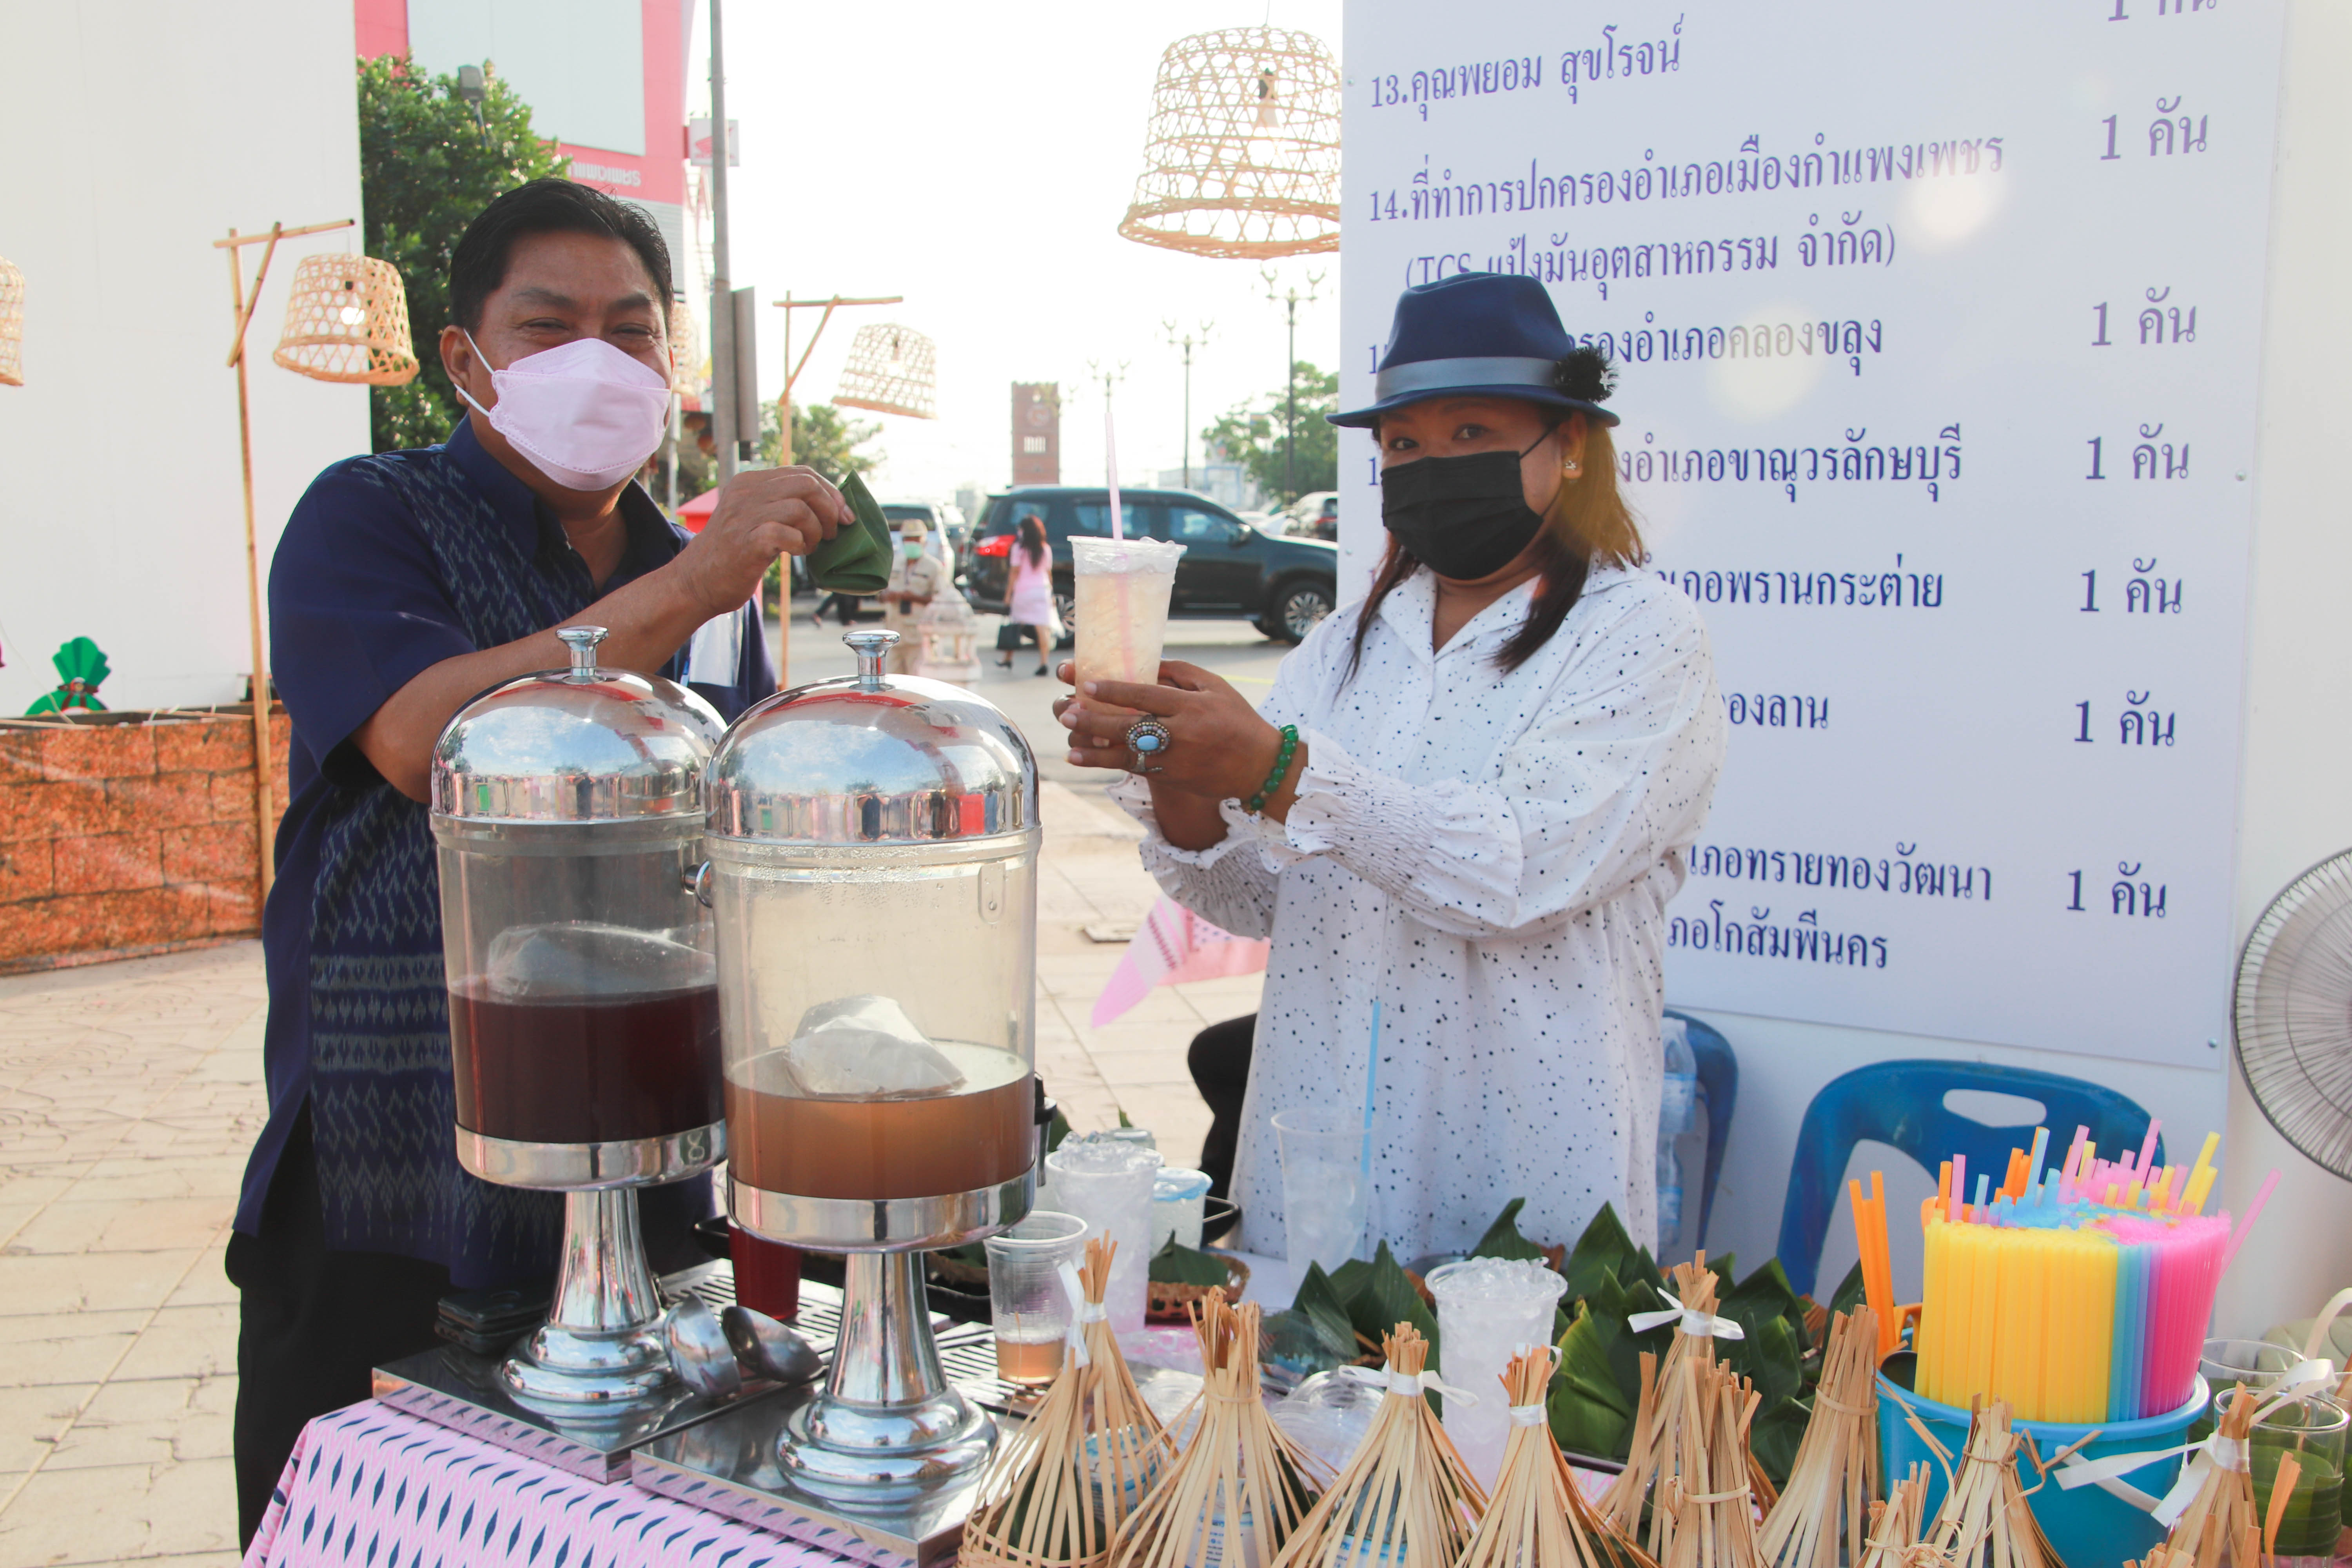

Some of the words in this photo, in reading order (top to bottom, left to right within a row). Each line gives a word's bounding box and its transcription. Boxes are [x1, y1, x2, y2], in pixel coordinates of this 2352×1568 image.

[1371, 56, 1542, 122] 13.คุณพยอม
[1561, 13, 1684, 105] สุขโรจน์
[2100, 115, 2121, 160] 1
[2149, 96, 2207, 156] คัน
[1370, 132, 2003, 221] 14.ที่ทำการปกครองอำเภอเมืองกำแพงเพชร
[1798, 211, 1895, 268] จำกัด)
[2091, 302, 2111, 346] 1
[2139, 287, 2196, 345] คัน
[2085, 437, 2105, 480] 1
[2132, 423, 2189, 480] คัน
[2080, 569, 2100, 612] 1
[2126, 558, 2182, 614] คัน
[1721, 693, 1828, 729] องลาน
[2074, 700, 2094, 743] 1
[2120, 690, 2175, 747] คัน
[2067, 869, 2086, 912] 1
[2111, 861, 2166, 919] คัน
